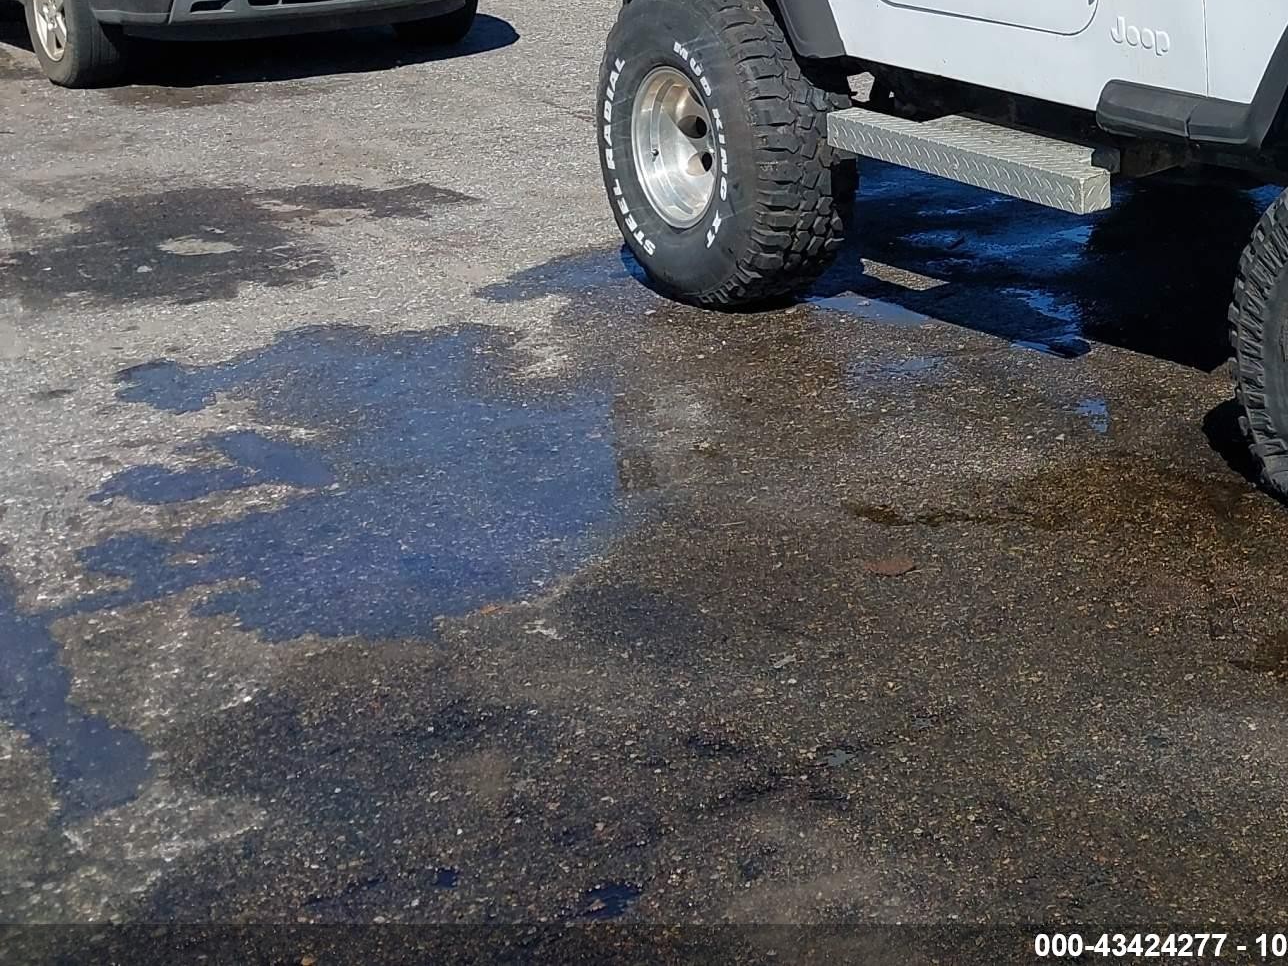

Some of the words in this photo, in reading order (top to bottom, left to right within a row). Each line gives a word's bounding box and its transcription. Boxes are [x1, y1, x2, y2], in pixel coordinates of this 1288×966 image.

[673, 41, 712, 98] MUD
[1110, 16, 1170, 57] Jeep
[602, 57, 626, 170] RADIAL
[711, 107, 728, 202] KING
[613, 178, 656, 257] STEEL
[706, 210, 722, 248] XT
